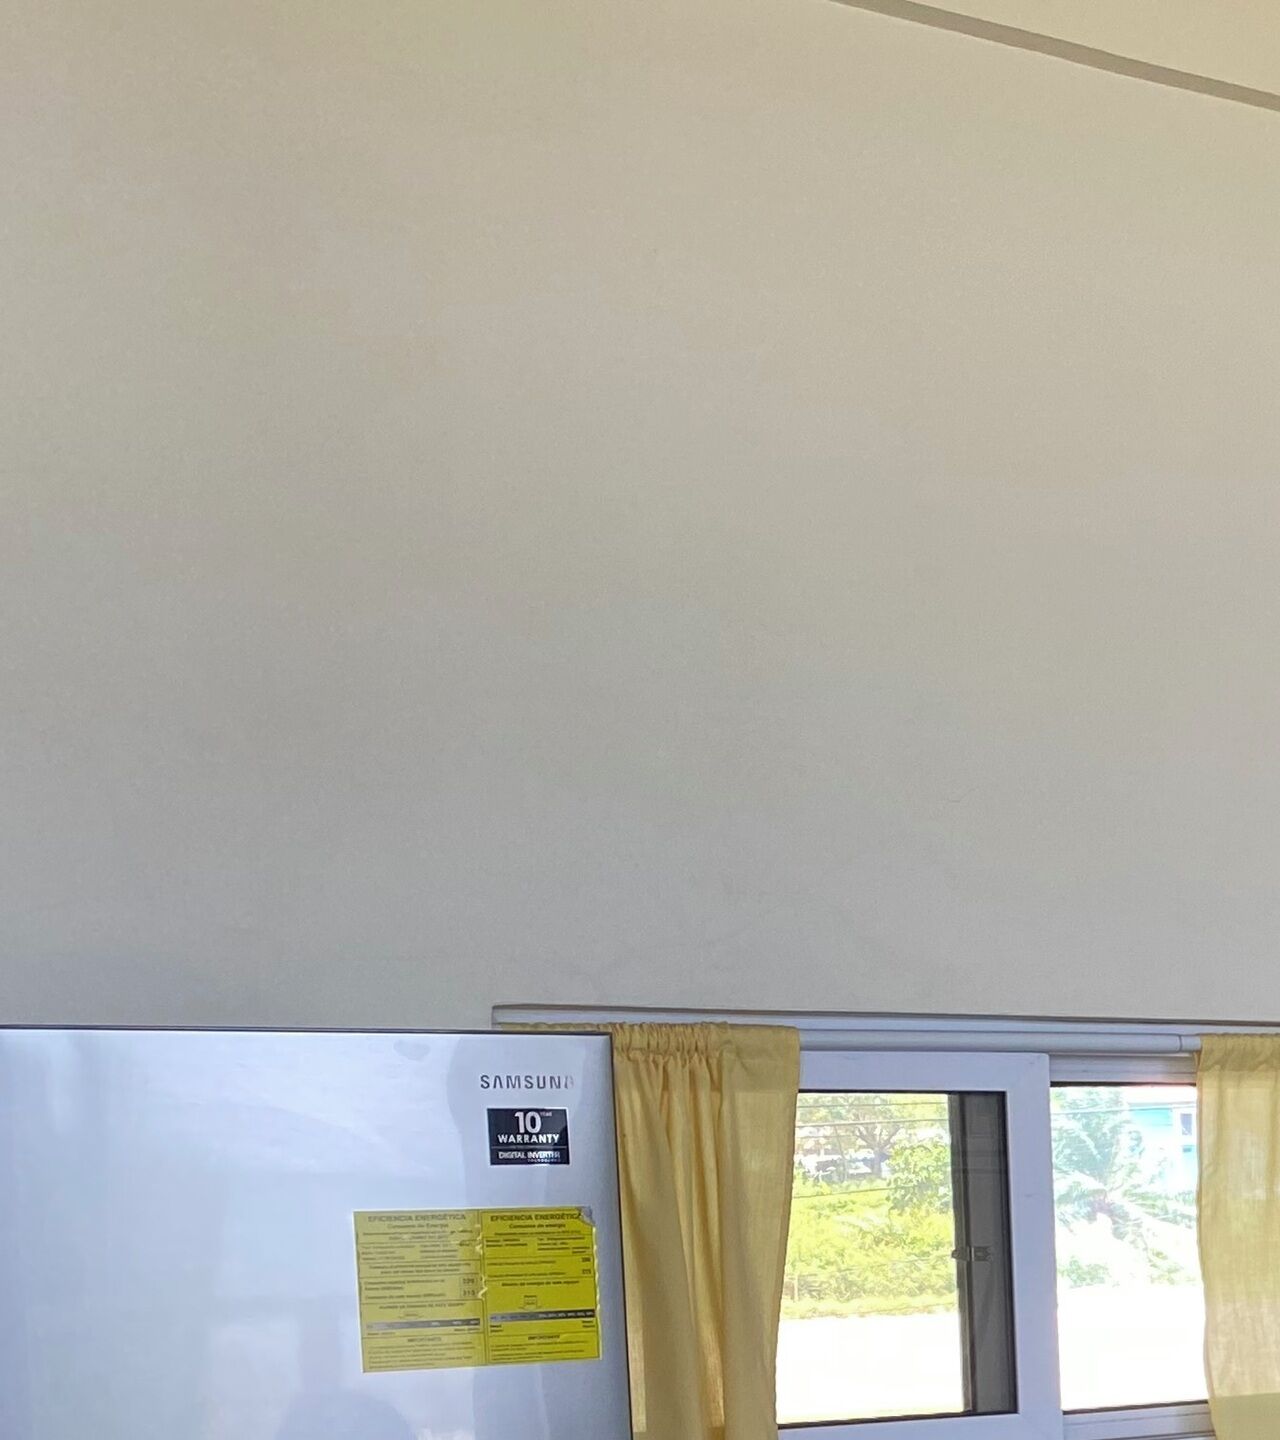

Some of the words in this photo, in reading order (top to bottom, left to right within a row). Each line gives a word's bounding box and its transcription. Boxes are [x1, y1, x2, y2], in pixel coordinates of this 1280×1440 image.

[514, 1111, 542, 1134] 10
[497, 1134, 560, 1144] WARRANTY
[498, 1151, 526, 1159] DIGITAL
